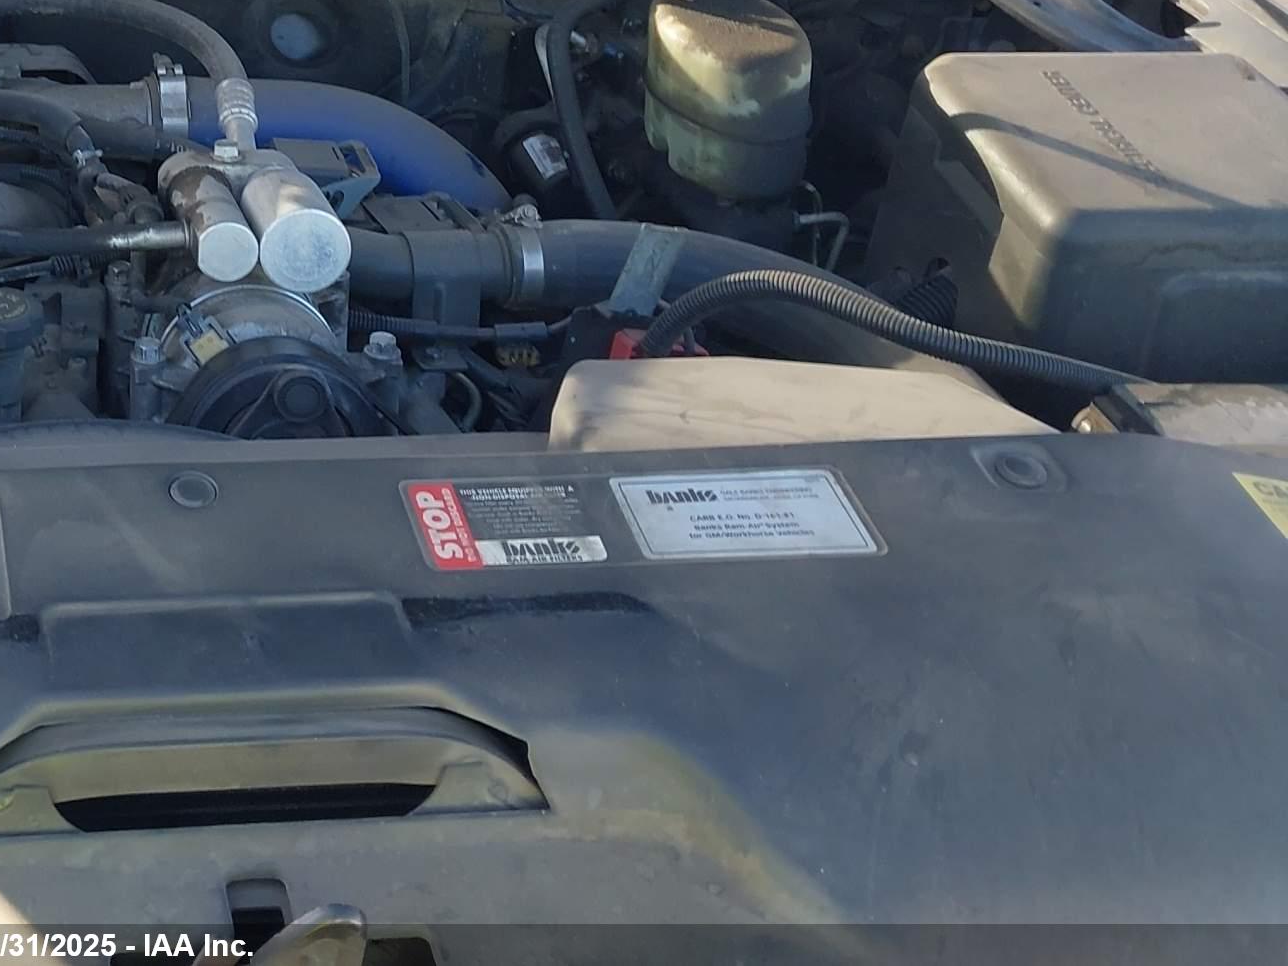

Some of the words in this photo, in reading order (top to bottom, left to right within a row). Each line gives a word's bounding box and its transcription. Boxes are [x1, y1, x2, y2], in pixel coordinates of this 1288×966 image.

[645, 488, 718, 505] banks
[415, 490, 464, 560] STOP
[501, 537, 580, 556] banks
